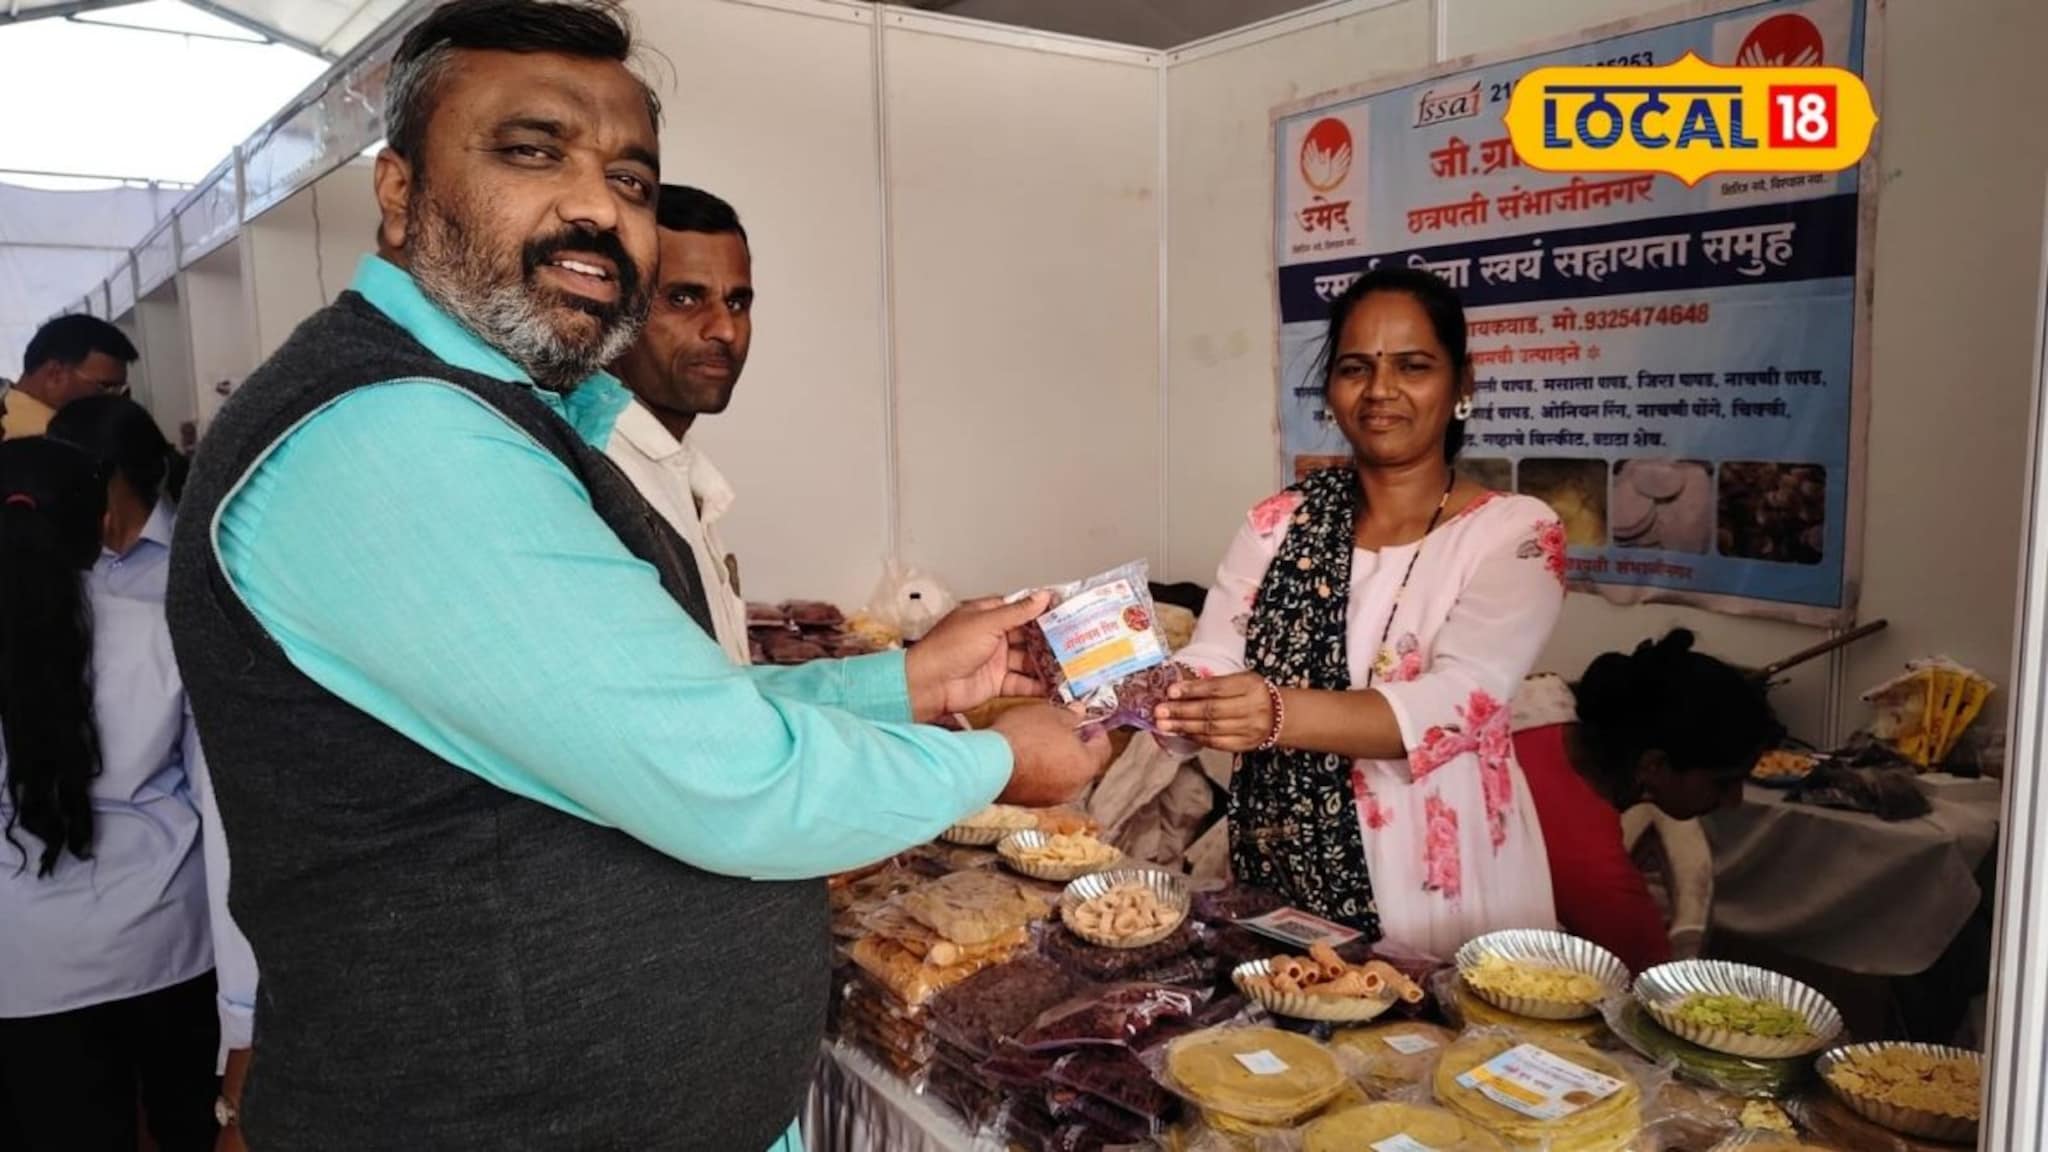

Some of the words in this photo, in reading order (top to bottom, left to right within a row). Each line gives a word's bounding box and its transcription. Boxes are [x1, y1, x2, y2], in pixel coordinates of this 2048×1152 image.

[1430, 136, 1521, 178] जी.ग्रा
[1300, 195, 1352, 233] उमेद
[1407, 191, 1490, 234] छत्रपती
[1497, 174, 1656, 221] संभाजीनगर
[1479, 237, 1544, 285] स्वयं
[1552, 233, 1691, 282] सहायता
[1702, 221, 1796, 276] समुह
[1467, 315, 1545, 337] ायकवाड,
[1552, 302, 1710, 333] मो.9325474648
[1543, 376, 1594, 391] मसाला
